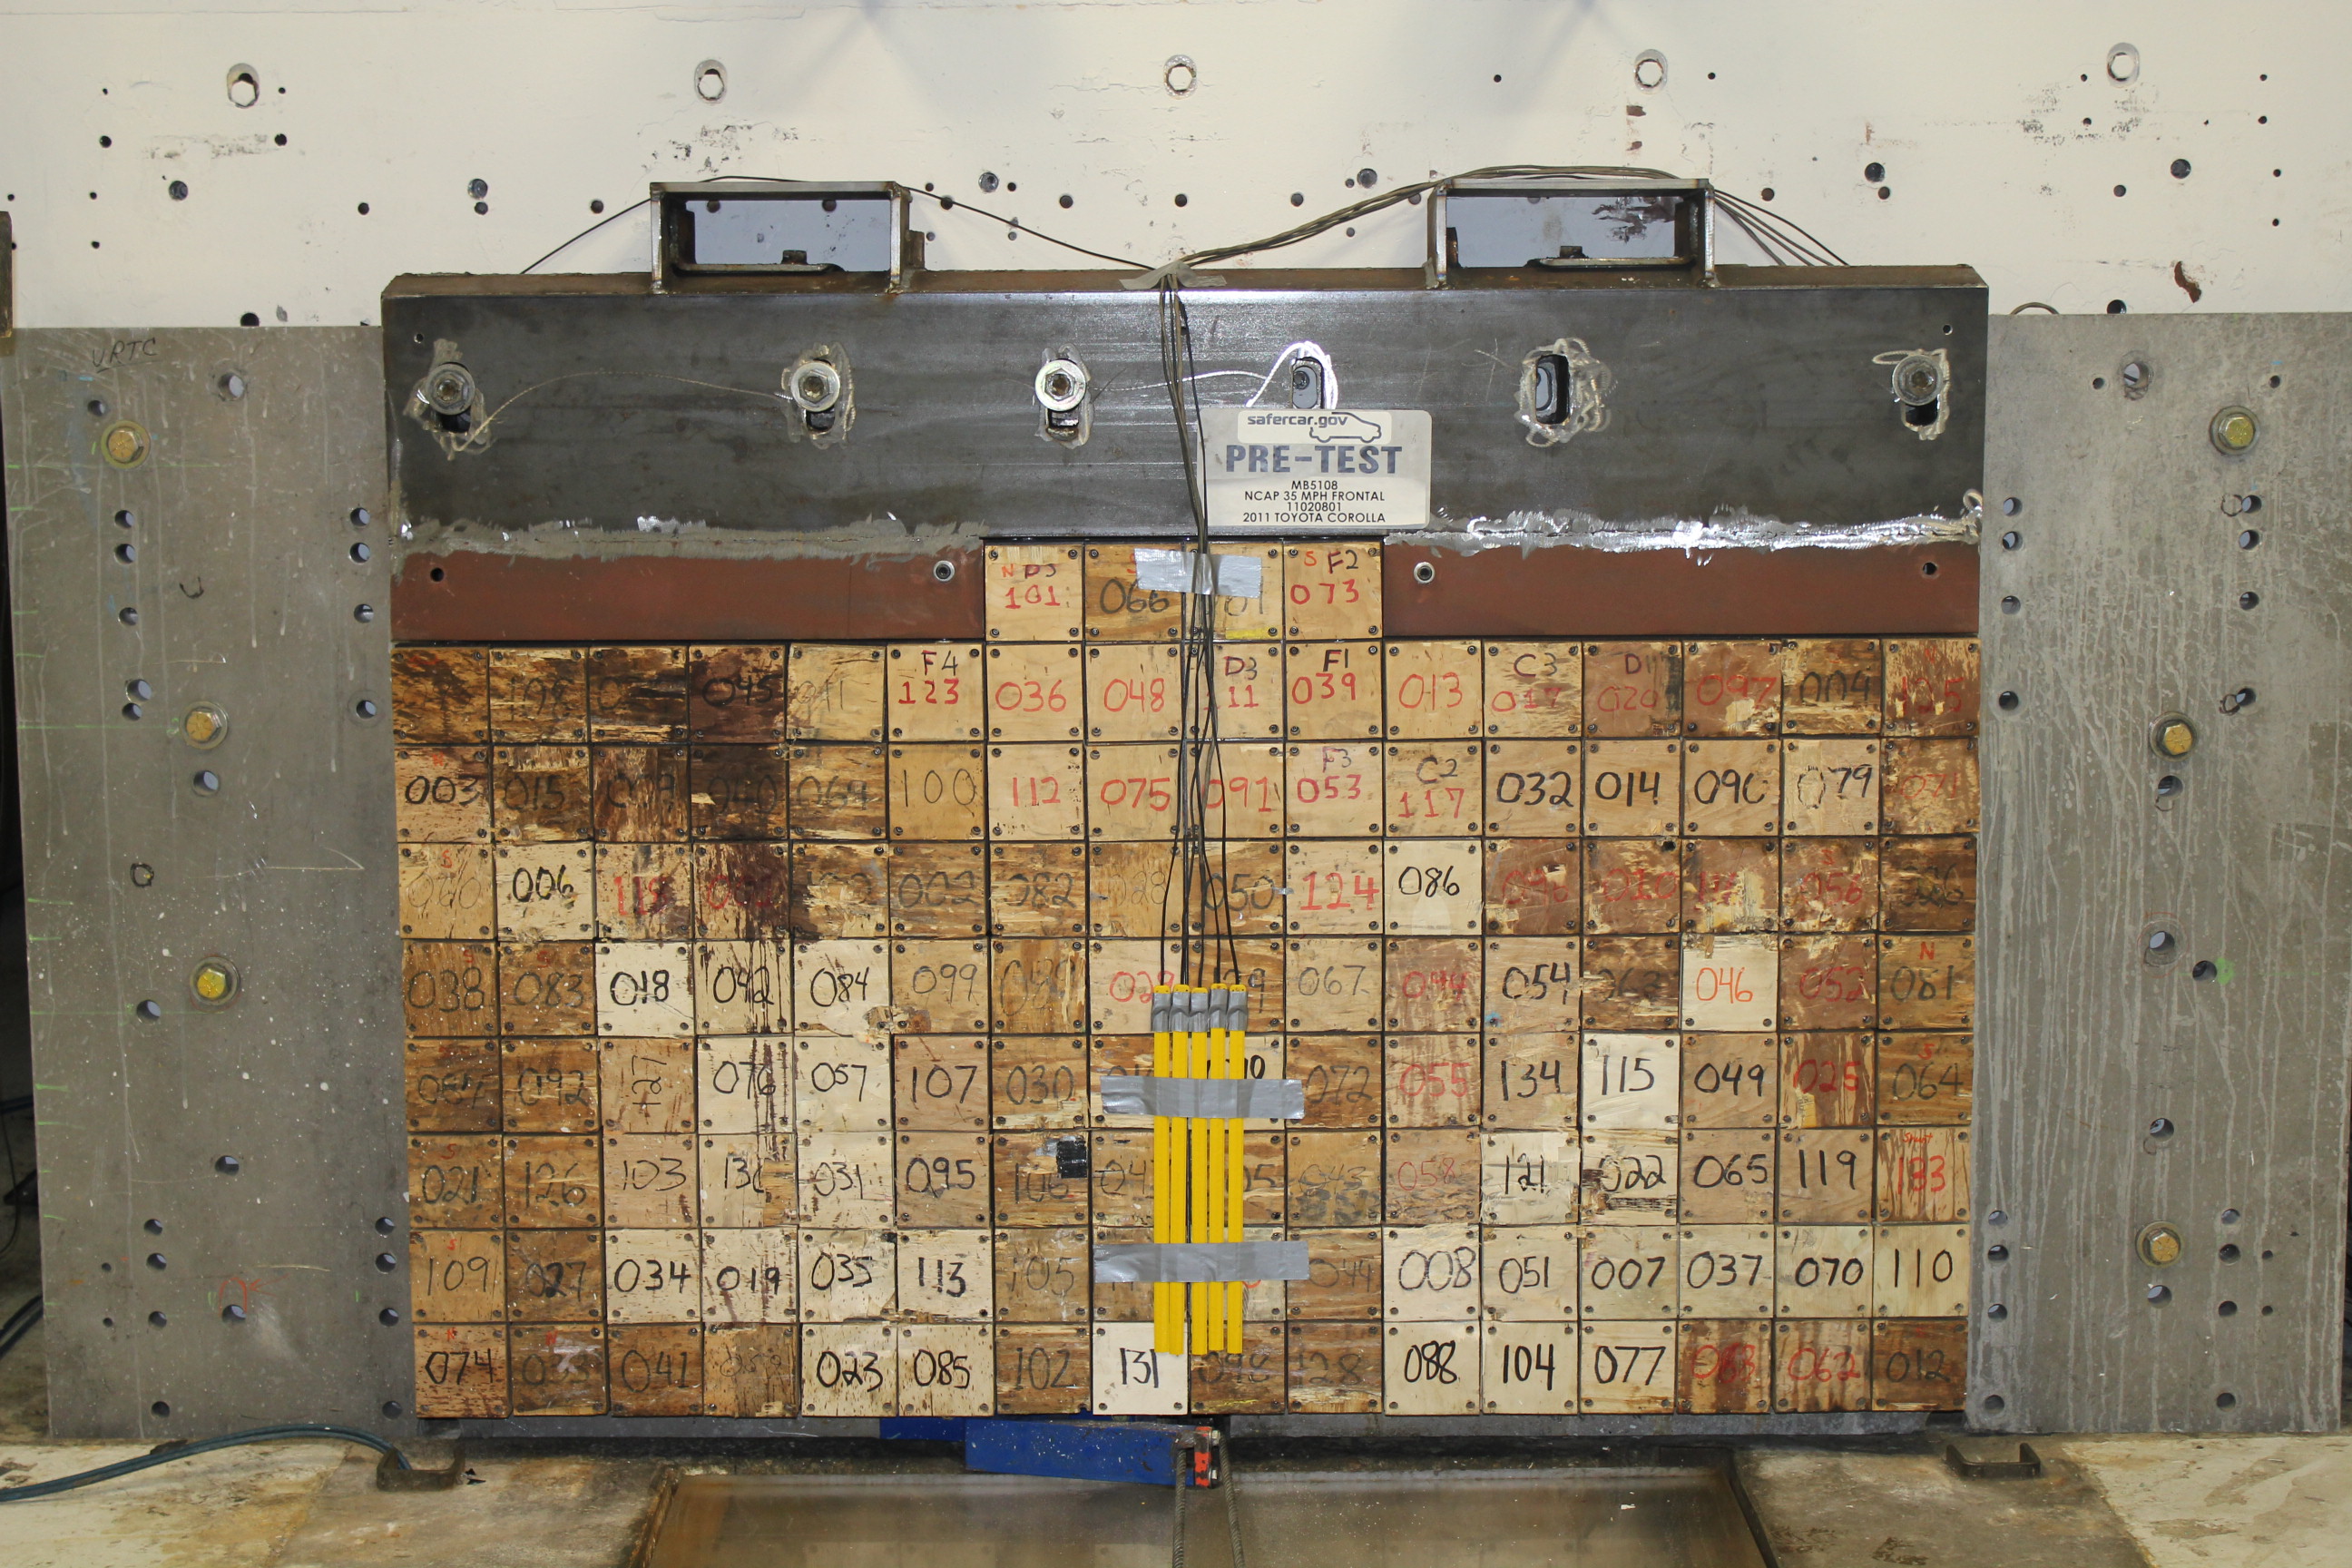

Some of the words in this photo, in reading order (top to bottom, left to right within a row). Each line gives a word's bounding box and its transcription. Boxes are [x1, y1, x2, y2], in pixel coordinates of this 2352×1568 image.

[1248, 413, 1348, 427] safercar.gov
[1226, 445, 1402, 474] PRE-TEST
[1244, 491, 1279, 501] NCAP
[1284, 491, 1297, 501] 35
[1301, 492, 1327, 501] MPH
[1332, 492, 1385, 501] FRONTAL
[1291, 481, 1338, 490] MB5108
[1243, 513, 1269, 523] 2011
[1274, 513, 1323, 523] TOYOTA
[1328, 513, 1386, 523] COROLLA
[1288, 503, 1341, 512] 11020801
[1004, 585, 1061, 609] 101
[1290, 579, 1359, 605] 073
[1225, 656, 1258, 680] D3
[1323, 649, 1348, 671] F1
[1514, 653, 1558, 678] C3
[703, 674, 782, 707] 045
[898, 678, 959, 704] 123
[995, 680, 1066, 712] 036
[1104, 678, 1165, 713] 048
[1292, 672, 1357, 704] 039
[1398, 672, 1463, 710] 013
[1597, 686, 1659, 712] 020
[1416, 756, 1458, 784] C2
[1797, 765, 1872, 809] 079
[405, 775, 480, 806] 003
[1013, 776, 1061, 808] 112
[1101, 777, 1171, 812] 075
[1298, 775, 1361, 803] 053
[1398, 789, 1464, 818] 117
[1496, 771, 1574, 808] 032
[1595, 771, 1661, 807] 014
[512, 864, 575, 903] 006
[1299, 871, 1379, 911] 124
[1398, 866, 1460, 897] 086
[1919, 943, 1935, 960] N
[408, 966, 485, 1012] 038
[610, 969, 671, 1005] 018
[712, 966, 774, 1004] 042
[809, 966, 869, 1007] 084
[913, 963, 978, 1007] 099
[1298, 965, 1367, 996] 067
[1502, 962, 1571, 1005] 054
[1696, 967, 1753, 1004] 046
[1889, 965, 1955, 1002] 081
[712, 1061, 777, 1100] 076
[811, 1062, 867, 1102] 057
[912, 1065, 977, 1103] 107
[1006, 1064, 1073, 1105] 030
[1399, 1062, 1470, 1097] 055
[1500, 1060, 1561, 1102] 134
[1596, 1055, 1655, 1096] 115
[1694, 1063, 1765, 1096] 049
[1891, 1062, 1964, 1101] 064
[623, 1158, 687, 1192] 103
[813, 1161, 864, 1200] 031
[906, 1156, 975, 1193] 095
[1397, 1157, 1455, 1191] 058
[1599, 1154, 1667, 1192] 022
[1693, 1153, 1768, 1189] 065
[1798, 1149, 1857, 1191] 119
[427, 1256, 489, 1297] 109
[614, 1259, 691, 1294] 034
[716, 1266, 780, 1294] 019
[811, 1251, 873, 1290] 035
[918, 1257, 966, 1298] 113
[1398, 1246, 1477, 1292] 008
[1498, 1256, 1550, 1294] 051
[1592, 1257, 1665, 1289] 007
[1687, 1251, 1762, 1289] 037
[1795, 1257, 1864, 1287] 070
[1894, 1248, 1953, 1289] 110
[425, 1348, 493, 1386] 074
[622, 1349, 691, 1393] 041
[816, 1350, 884, 1393] 023
[914, 1348, 971, 1388] 085
[1120, 1348, 1160, 1388] 131
[1404, 1339, 1459, 1385] 088
[1503, 1343, 1555, 1391] 104
[1594, 1345, 1666, 1386] 077
